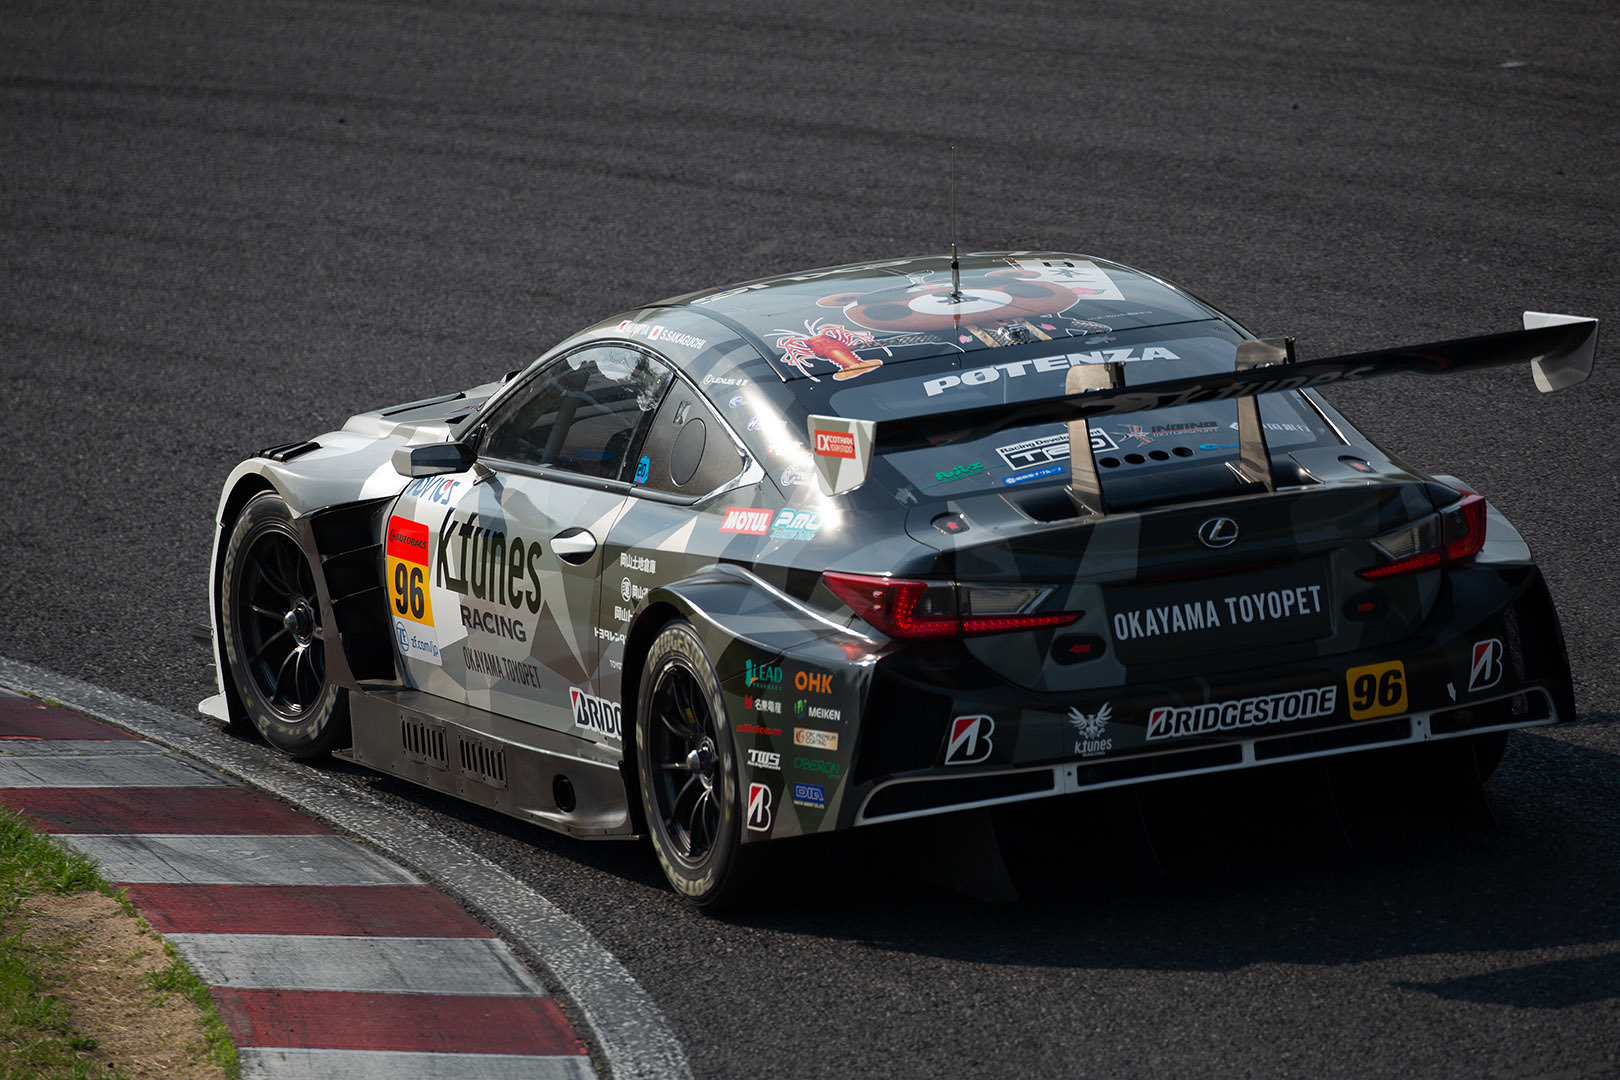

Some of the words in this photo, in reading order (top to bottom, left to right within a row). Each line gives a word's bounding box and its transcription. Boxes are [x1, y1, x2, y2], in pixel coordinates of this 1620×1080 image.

[660, 329, 707, 350] S.SAKAGUCHI
[923, 346, 1181, 398] POTENZA
[1000, 441, 1036, 454] Racing
[722, 511, 769, 532] MOTUL
[396, 532, 427, 550] AUTOBACS
[395, 562, 425, 620] 96
[460, 604, 527, 642] RACING
[1114, 601, 1221, 642] OKAYAMA
[1224, 585, 1321, 625] TOYOPET
[463, 646, 503, 679] OKAYAMA
[502, 657, 541, 689] TOYOPET
[794, 671, 833, 695] OHK
[1352, 669, 1403, 712] 96
[808, 706, 841, 721] MEIKEN
[1148, 686, 1336, 740] BRIDGESTONE
[736, 723, 782, 736] nikken
[747, 749, 781, 766] TWS
